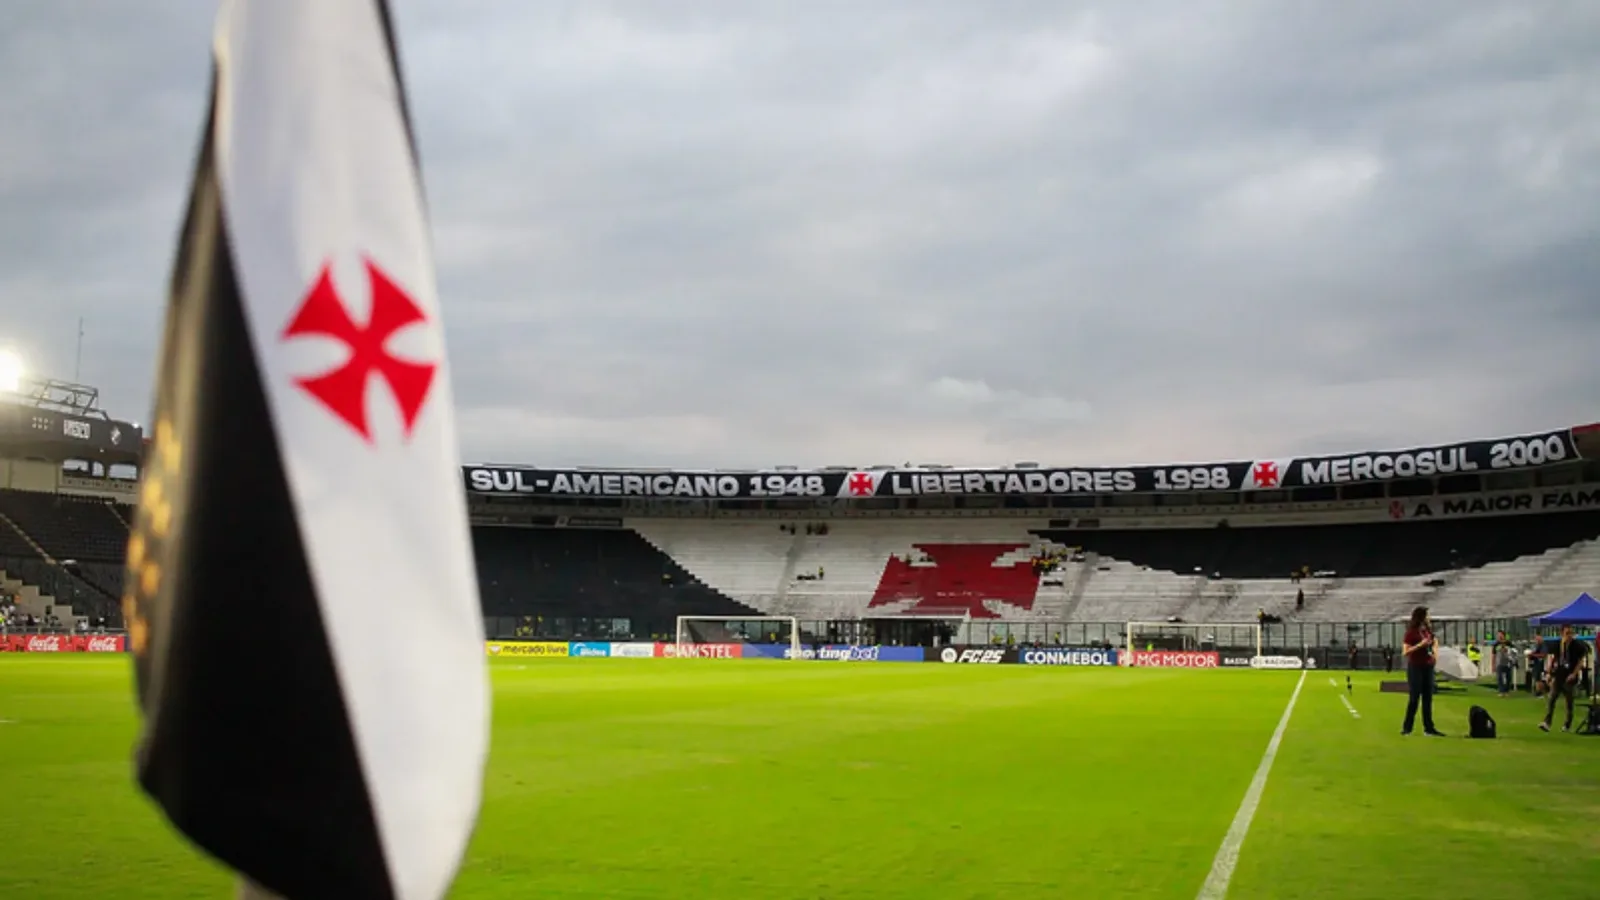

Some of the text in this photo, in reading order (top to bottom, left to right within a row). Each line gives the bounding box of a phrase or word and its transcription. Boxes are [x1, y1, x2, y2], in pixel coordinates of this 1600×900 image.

[1302, 435, 1565, 484] MERCOSUL 2000
[471, 469, 826, 497] SUL-AMERICANO 1948
[891, 466, 1230, 495] LIBERTADORES 1998
[1413, 489, 1600, 517] A MAIOR FAM
[503, 643, 567, 655] mercado livre
[679, 643, 734, 658] AMSTEL
[783, 645, 880, 661] sortingbet
[1023, 650, 1113, 666] CONMEBOL
[1136, 653, 1161, 667] MG
[1163, 653, 1218, 667] MOTOR
